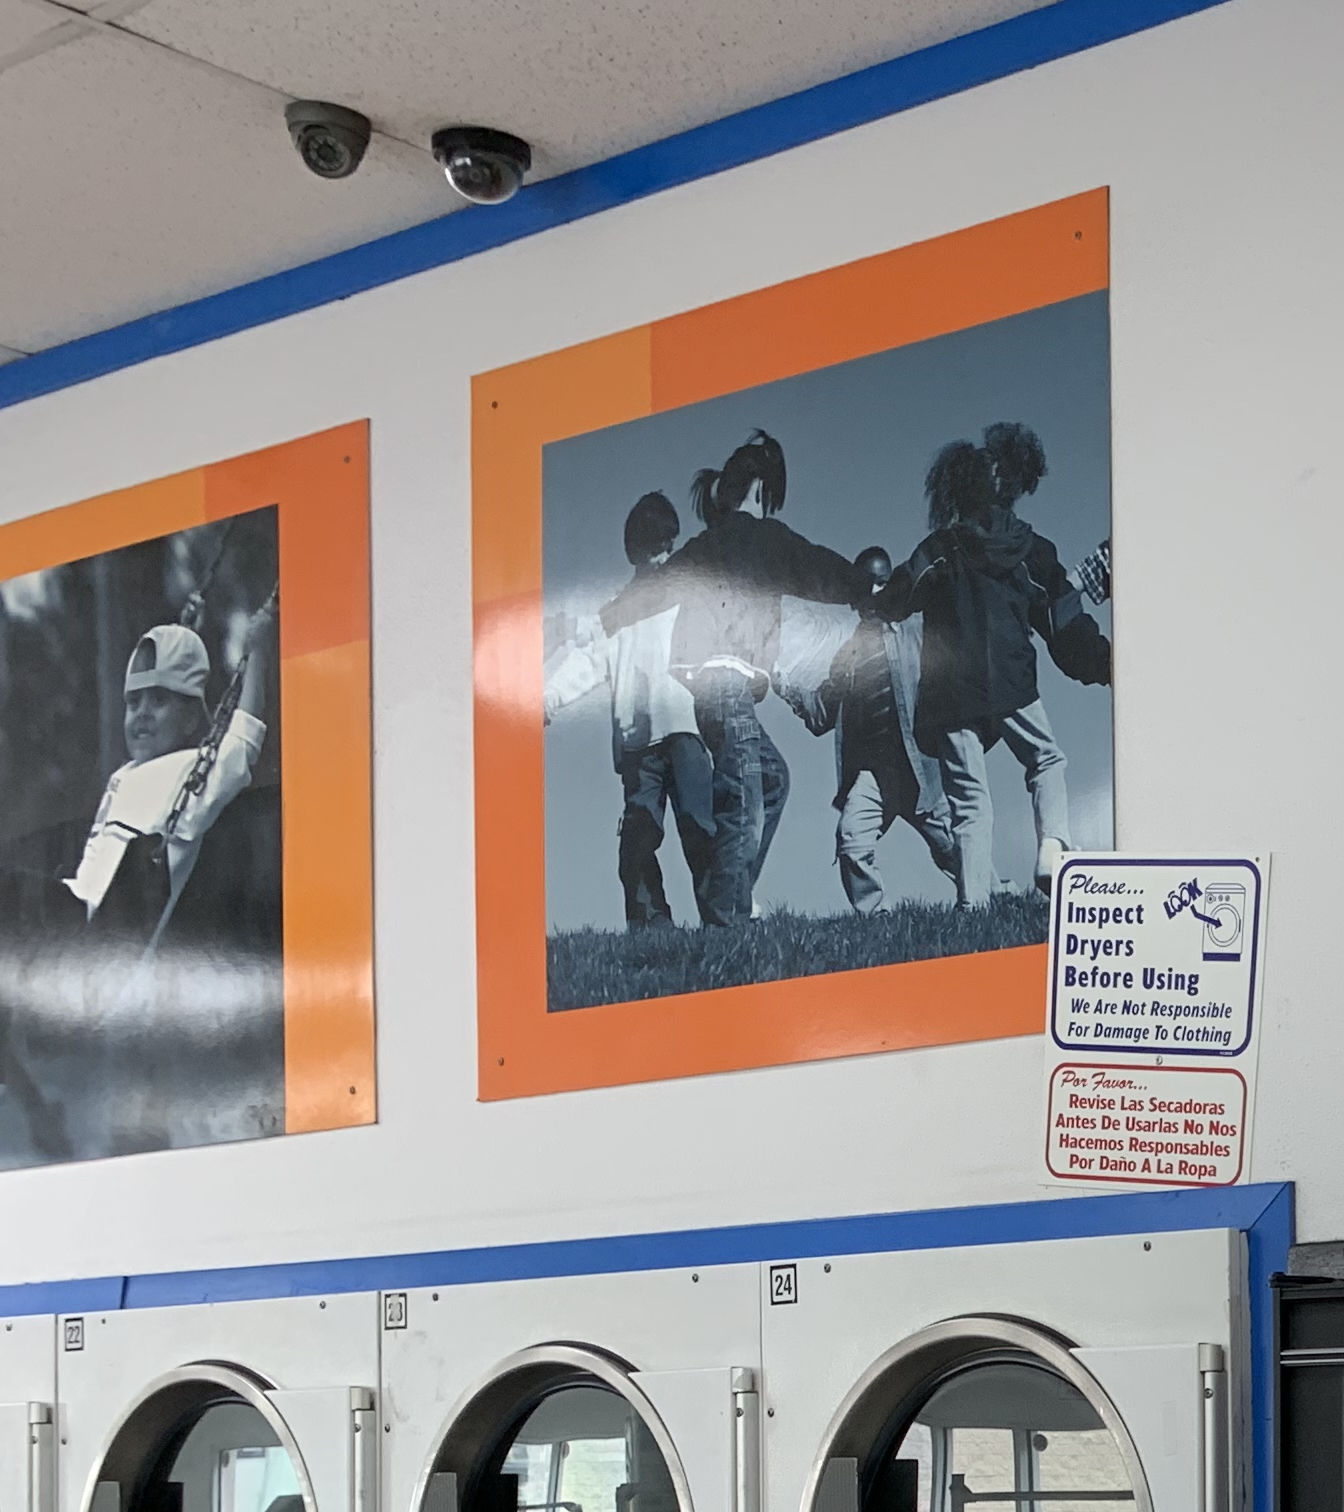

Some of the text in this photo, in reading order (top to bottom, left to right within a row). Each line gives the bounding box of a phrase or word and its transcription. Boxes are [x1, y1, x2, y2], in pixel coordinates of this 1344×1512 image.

[1069, 874, 1144, 895] Please...
[1163, 878, 1204, 919] LOOK
[1067, 902, 1145, 929] Inspect
[1066, 934, 1135, 961] Dryers
[1064, 965, 1200, 996] Before Using
[1071, 998, 1232, 1020] We Are Not Responsible
[1068, 1022, 1232, 1046] For Damage To Clothing
[1061, 1070, 1087, 1088] Por
[1069, 1094, 1225, 1115] Revise Las Secadoras
[1056, 1114, 1237, 1137] Antes De Usarlas No Nos
[1059, 1134, 1231, 1158] Hacemos Responsables
[1069, 1155, 1217, 1178] Por Daño A La Ropa
[774, 1274, 793, 1296] 24
[66, 1326, 81, 1344] 22
